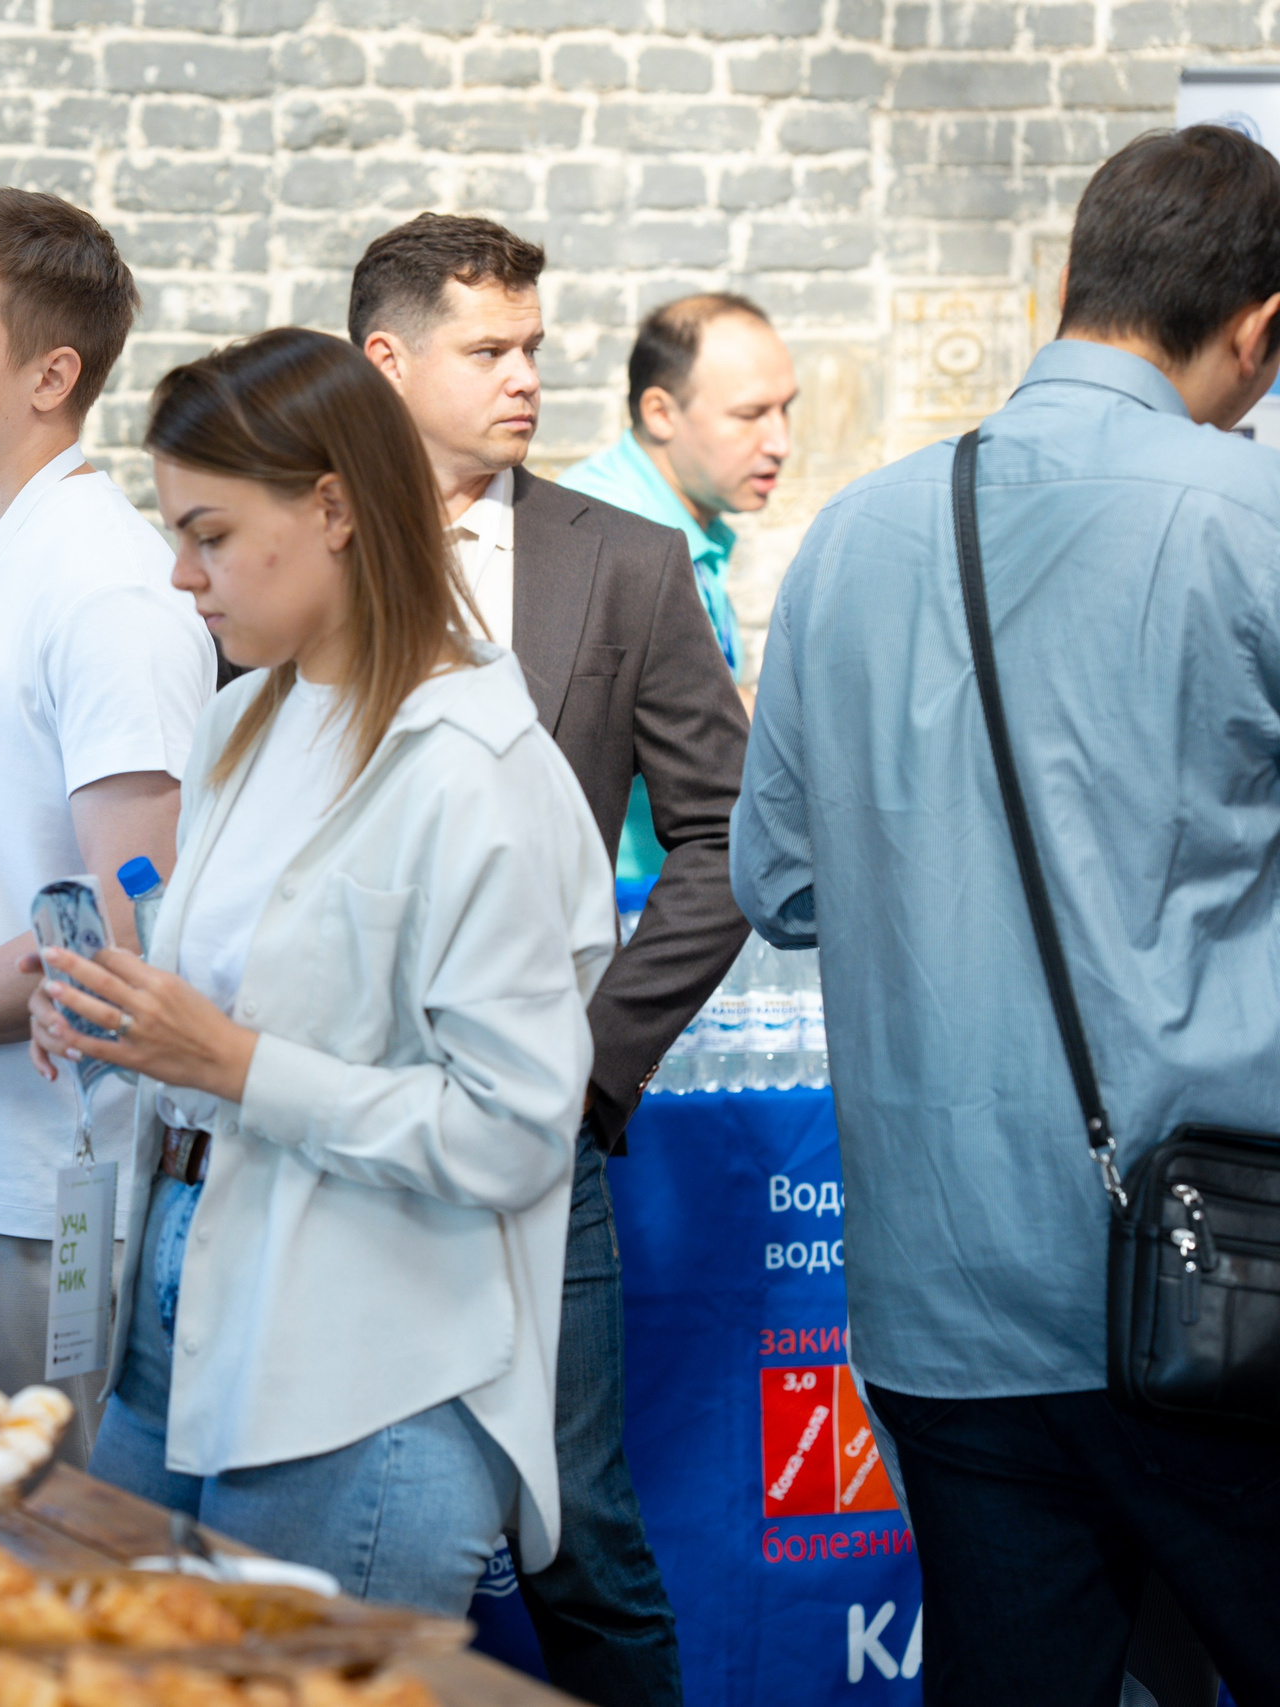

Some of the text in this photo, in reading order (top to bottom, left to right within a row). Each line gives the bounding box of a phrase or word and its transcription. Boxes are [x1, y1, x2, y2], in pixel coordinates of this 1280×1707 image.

[769, 1174, 845, 1218] Вод
[61, 1212, 88, 1237] УЧА
[59, 1242, 77, 1265] СТ
[57, 1267, 87, 1293] НИК
[782, 1371, 817, 1393] 3,0
[767, 1404, 830, 1502] Кока-кола
[840, 1442, 881, 1506] апельс
[762, 1526, 913, 1564] болезни
